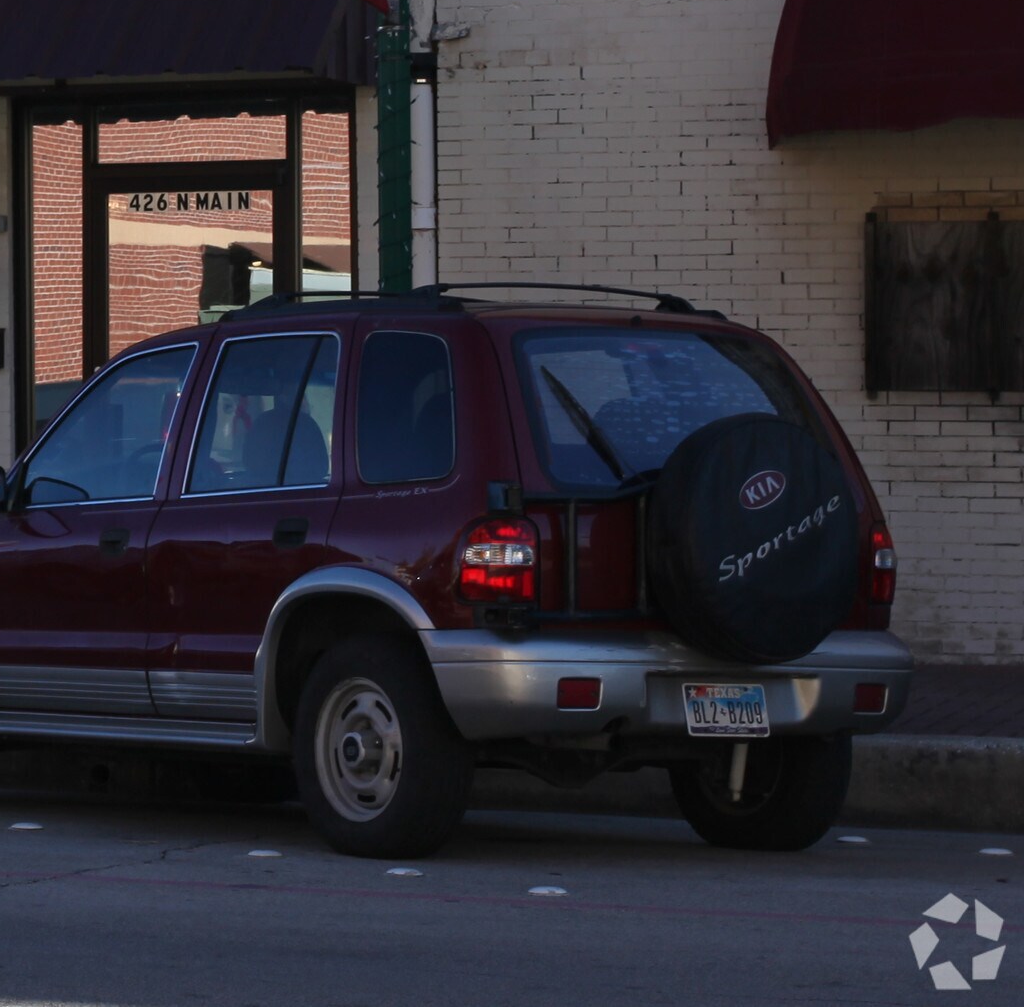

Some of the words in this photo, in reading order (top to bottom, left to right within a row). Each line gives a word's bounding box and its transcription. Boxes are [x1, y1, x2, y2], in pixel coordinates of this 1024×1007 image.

[129, 193, 168, 212] 426
[177, 193, 189, 211] N
[195, 192, 250, 211] MAIN
[744, 476, 780, 504] KIA
[718, 494, 841, 582] Sportage
[706, 687, 741, 699] TEXAS
